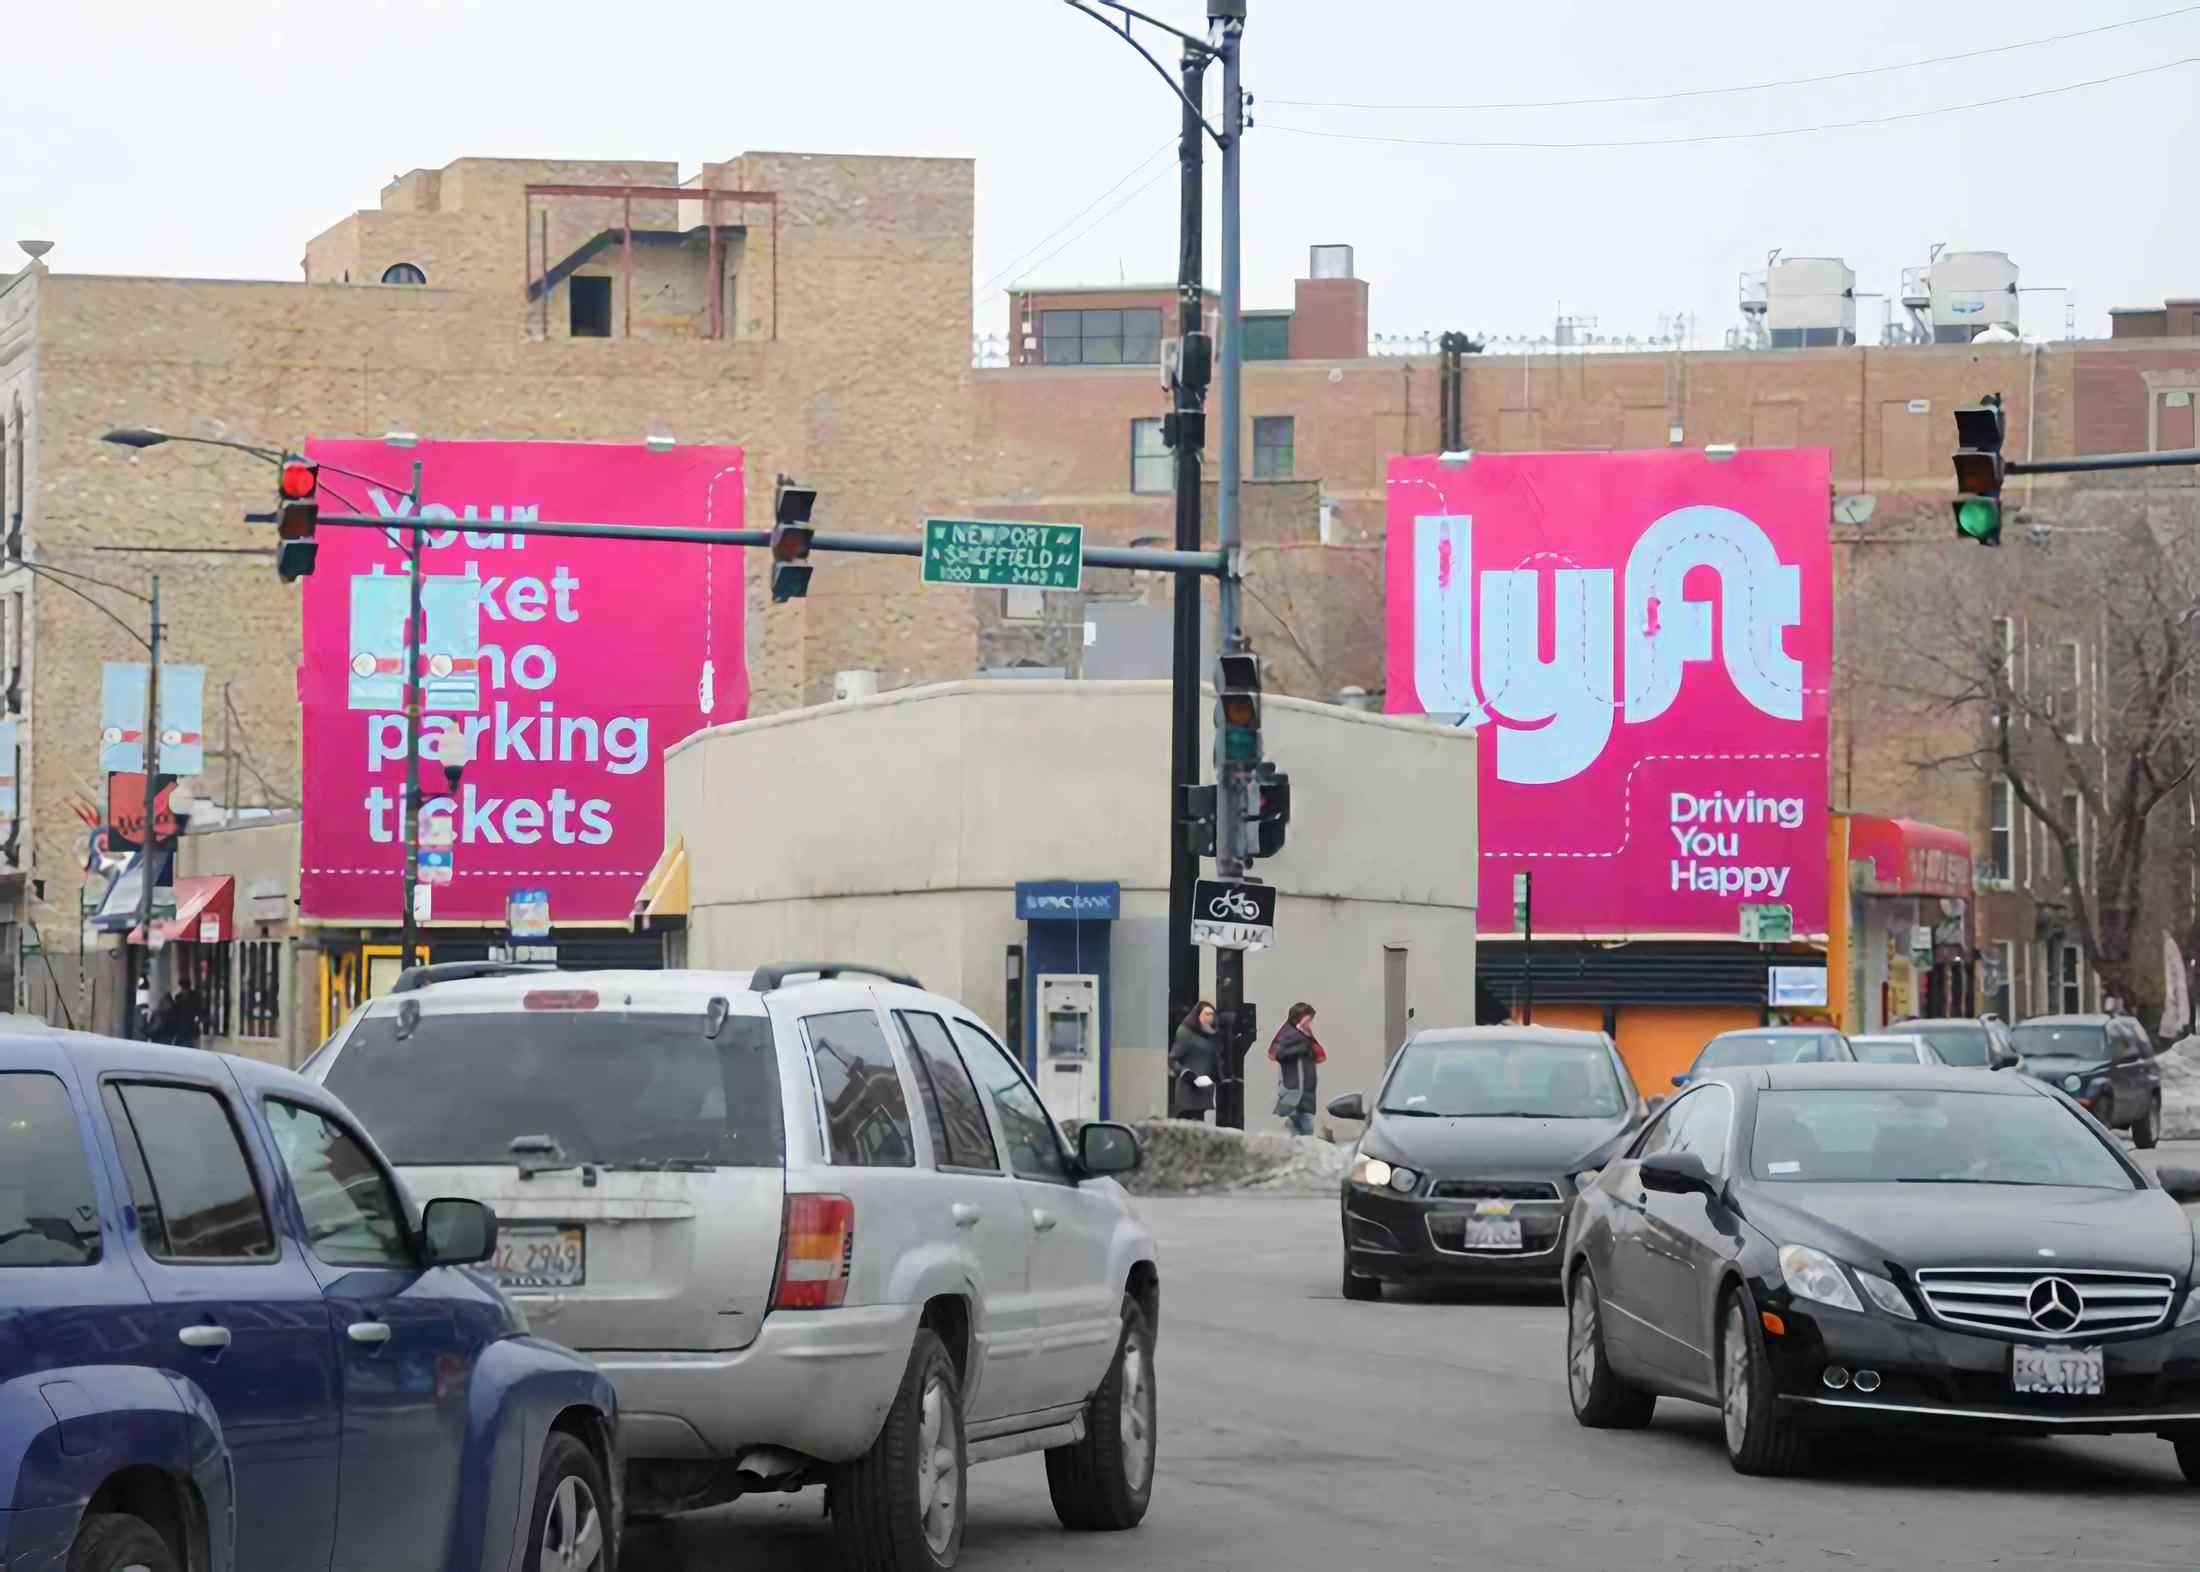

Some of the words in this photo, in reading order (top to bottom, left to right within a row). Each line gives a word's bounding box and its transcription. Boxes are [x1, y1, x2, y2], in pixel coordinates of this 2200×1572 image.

[367, 486, 539, 549] Your
[952, 524, 1050, 547] NEWPORT
[944, 544, 1053, 568] SHEFFIELD
[1414, 505, 1803, 785] lyft
[368, 701, 649, 775] parking
[364, 783, 613, 844] tickets
[1670, 791, 1804, 829] Driving
[1670, 825, 1739, 857] You
[1670, 860, 1791, 898] Happy
